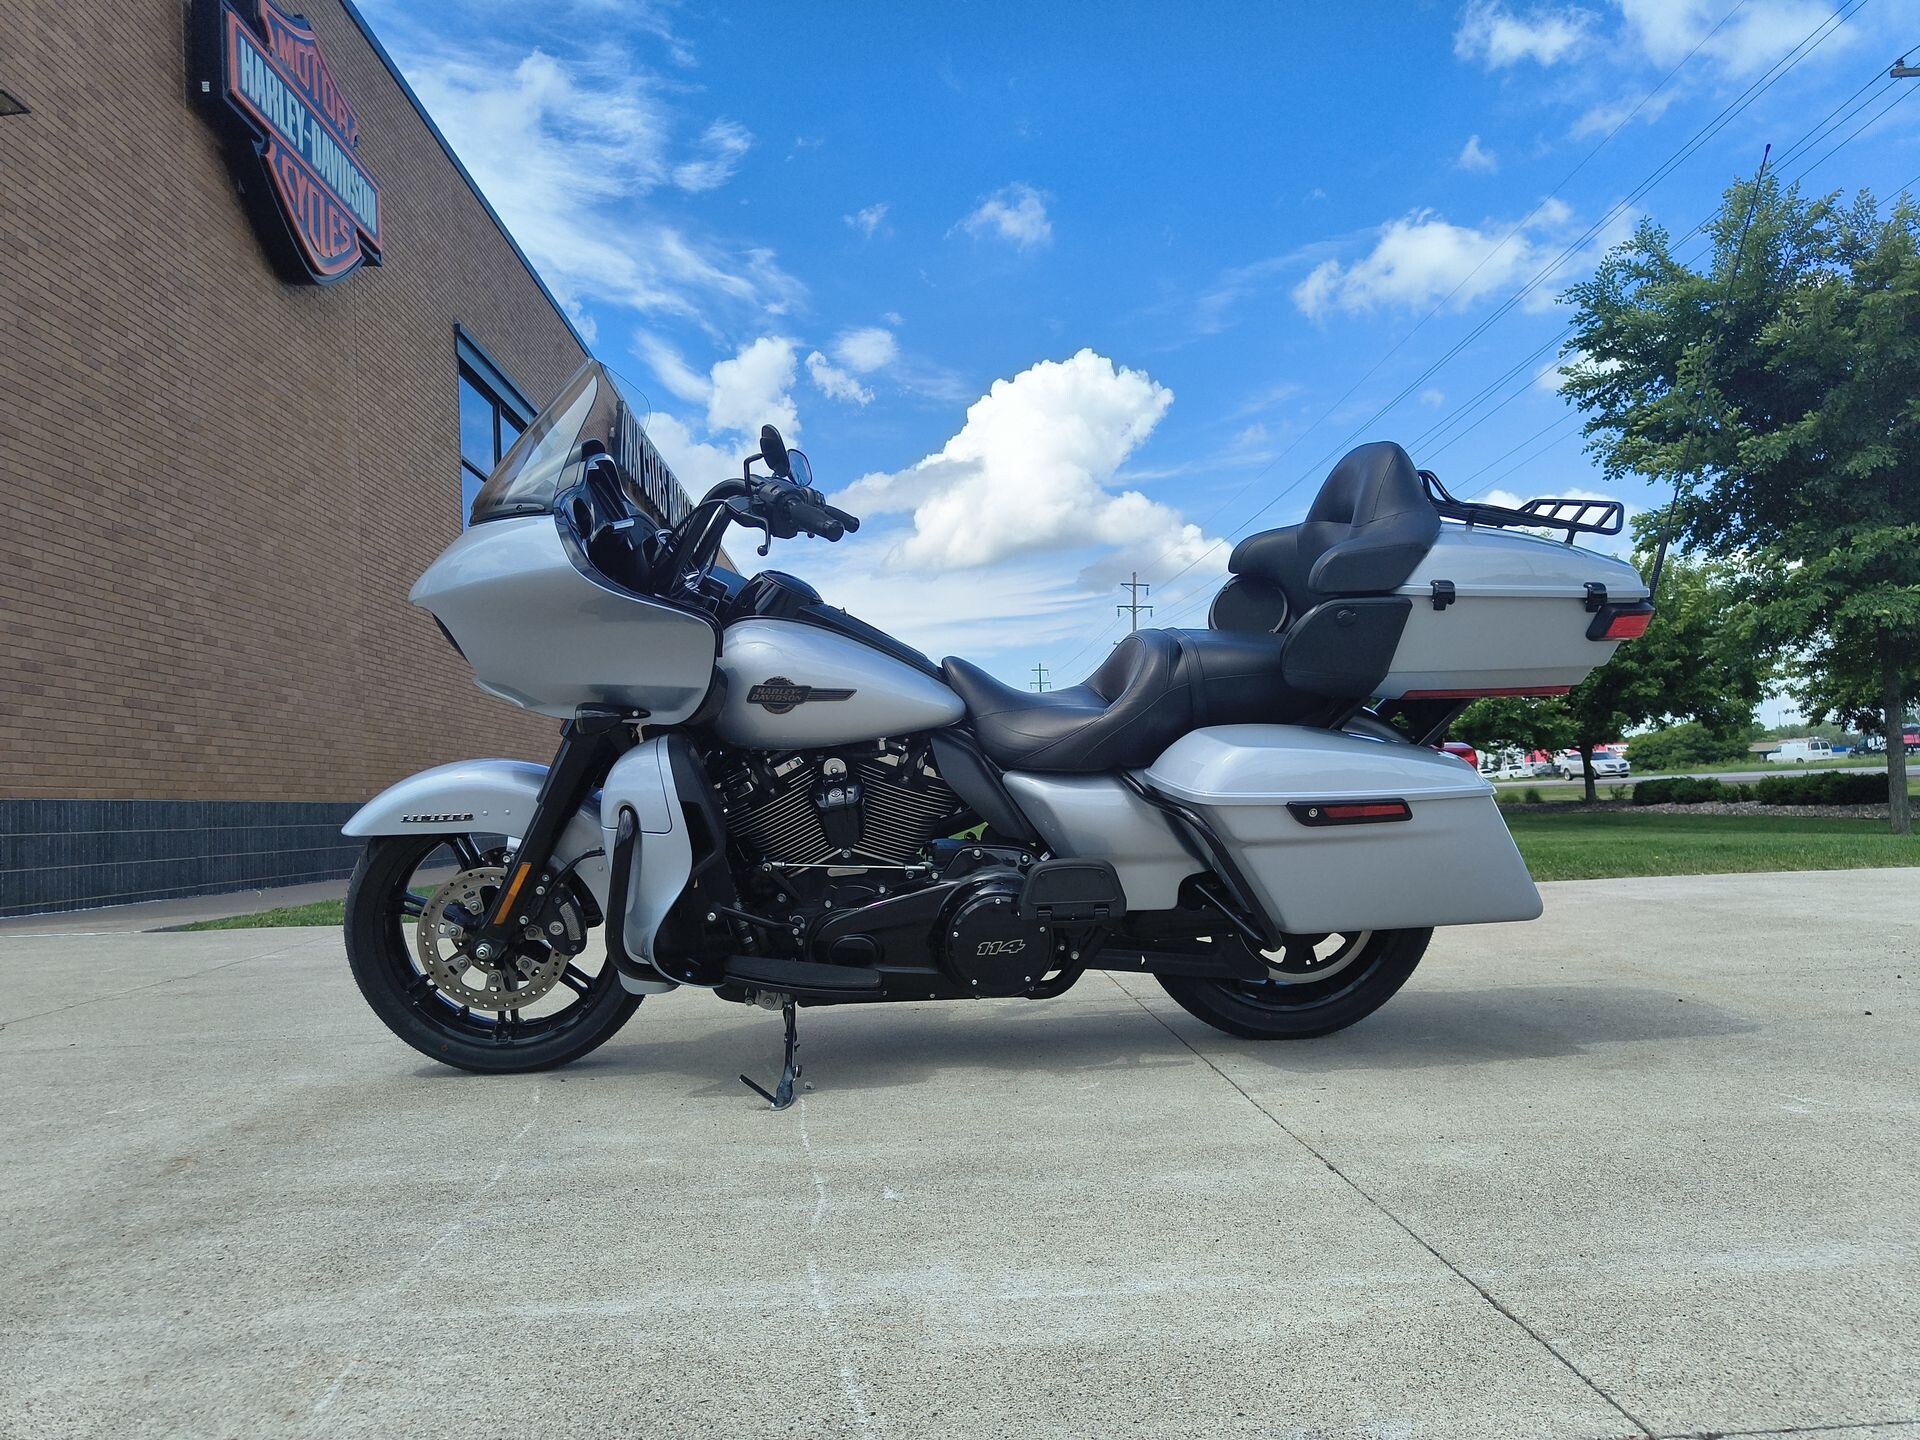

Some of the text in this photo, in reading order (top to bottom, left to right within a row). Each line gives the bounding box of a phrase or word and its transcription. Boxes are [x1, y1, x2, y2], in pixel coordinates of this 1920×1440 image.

[277, 27, 352, 140] MOTOR
[240, 36, 378, 235] HARLEY-DAVIDSON
[281, 154, 351, 258] CYCLES
[751, 694, 801, 702] DAVIDSON
[400, 813, 475, 823] LIMITED
[977, 939, 1026, 955] 114
